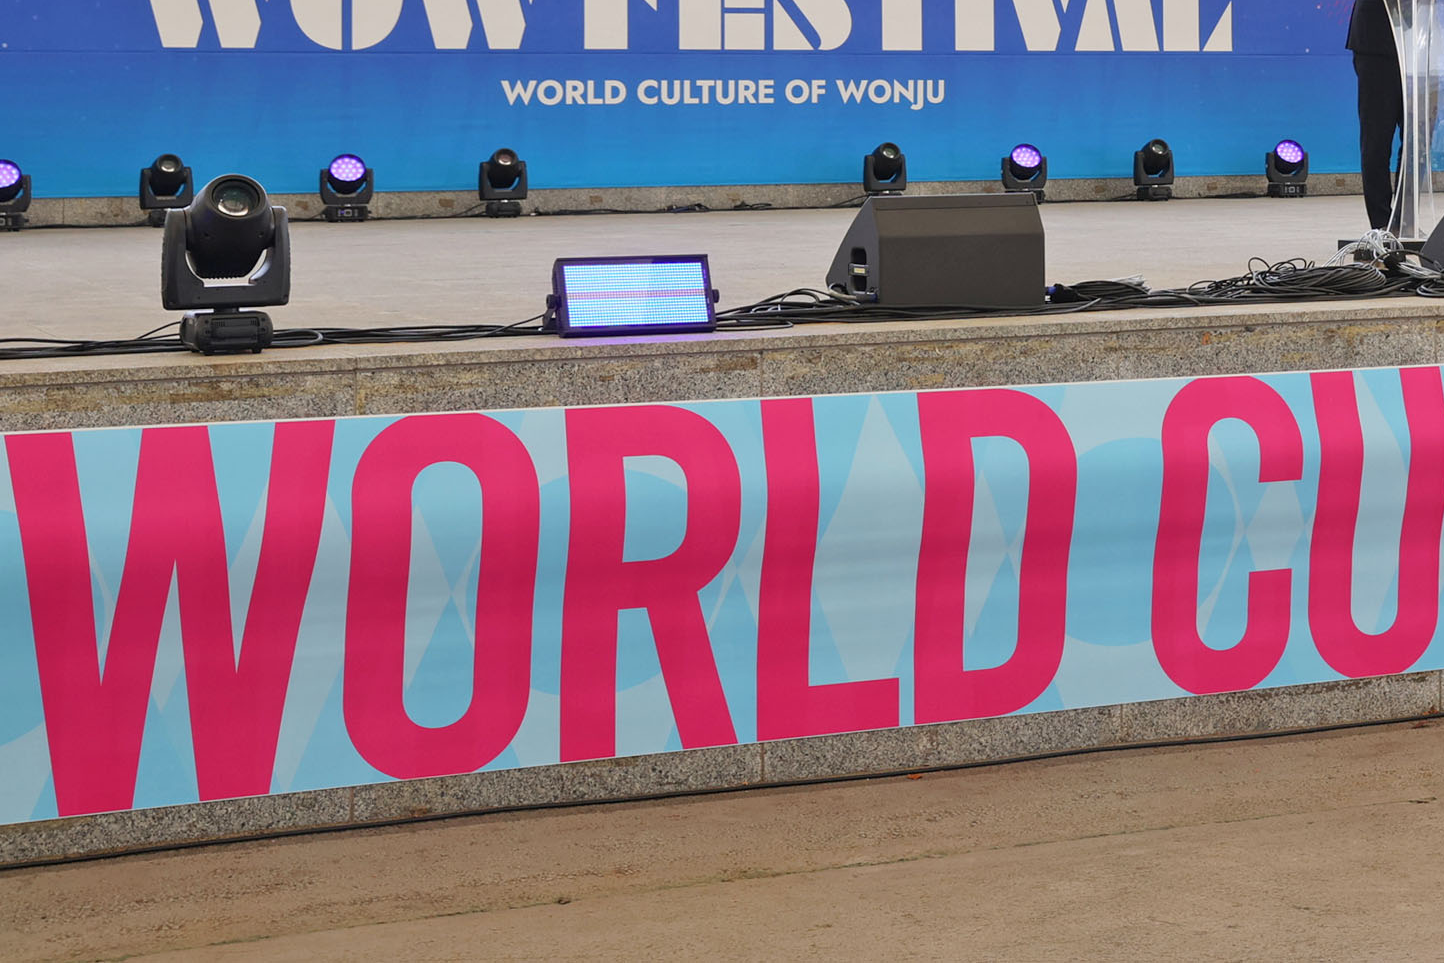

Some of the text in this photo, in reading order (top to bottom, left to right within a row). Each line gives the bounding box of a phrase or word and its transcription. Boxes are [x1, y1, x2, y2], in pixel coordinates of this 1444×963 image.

[501, 79, 945, 111] WORLD CULTURE OF WONJU
[5, 388, 1077, 818] WORLD
